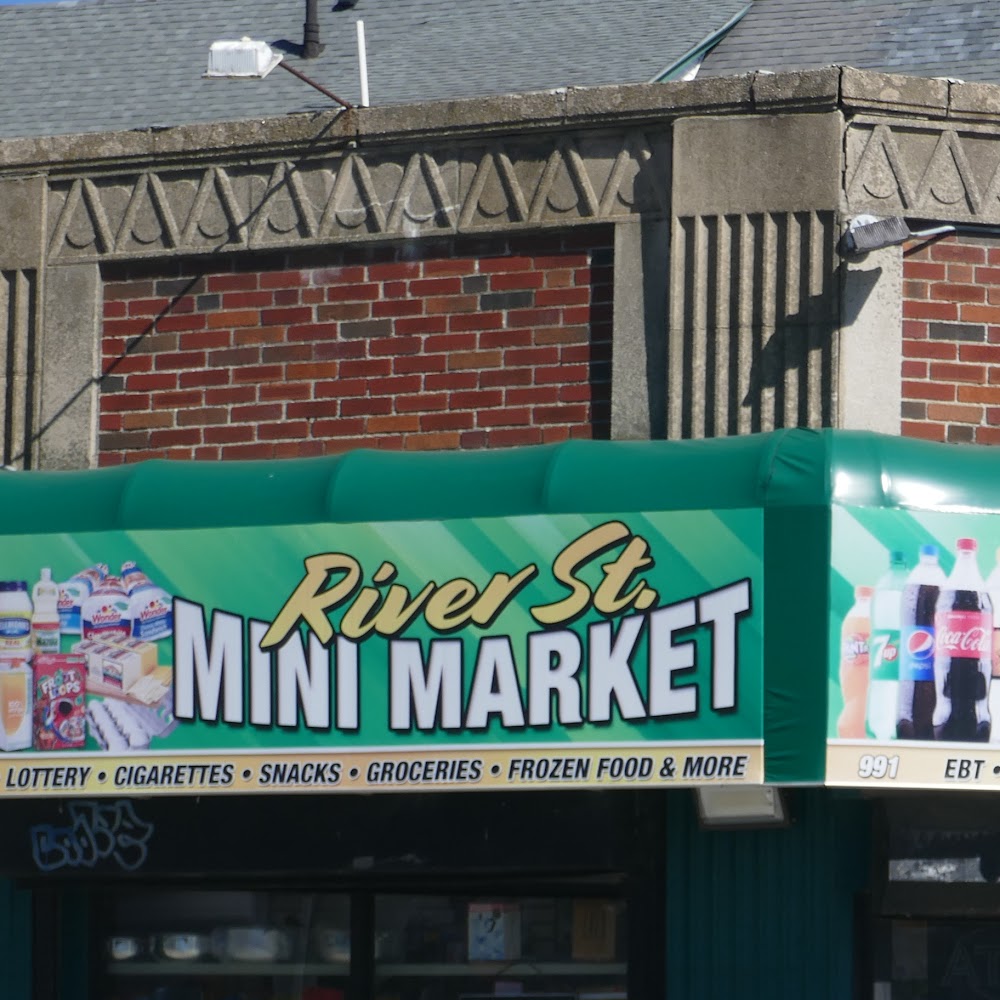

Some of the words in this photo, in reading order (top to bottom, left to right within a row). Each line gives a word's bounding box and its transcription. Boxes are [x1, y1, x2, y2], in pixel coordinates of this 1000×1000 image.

[260, 552, 539, 653] River
[530, 520, 658, 628] St.
[173, 597, 360, 733] MINI
[389, 577, 753, 733] MARKET
[6, 766, 92, 789] LOTTERY
[114, 764, 235, 787] CIGARETTES
[259, 763, 342, 785] SNACKS
[366, 760, 483, 784] GROCERIES
[508, 758, 591, 780] FROZEN
[596, 757, 655, 779] FOOD
[659, 758, 677, 778] &
[681, 756, 748, 778] MORE
[858, 754, 900, 780] 991
[944, 758, 986, 779] EBT
